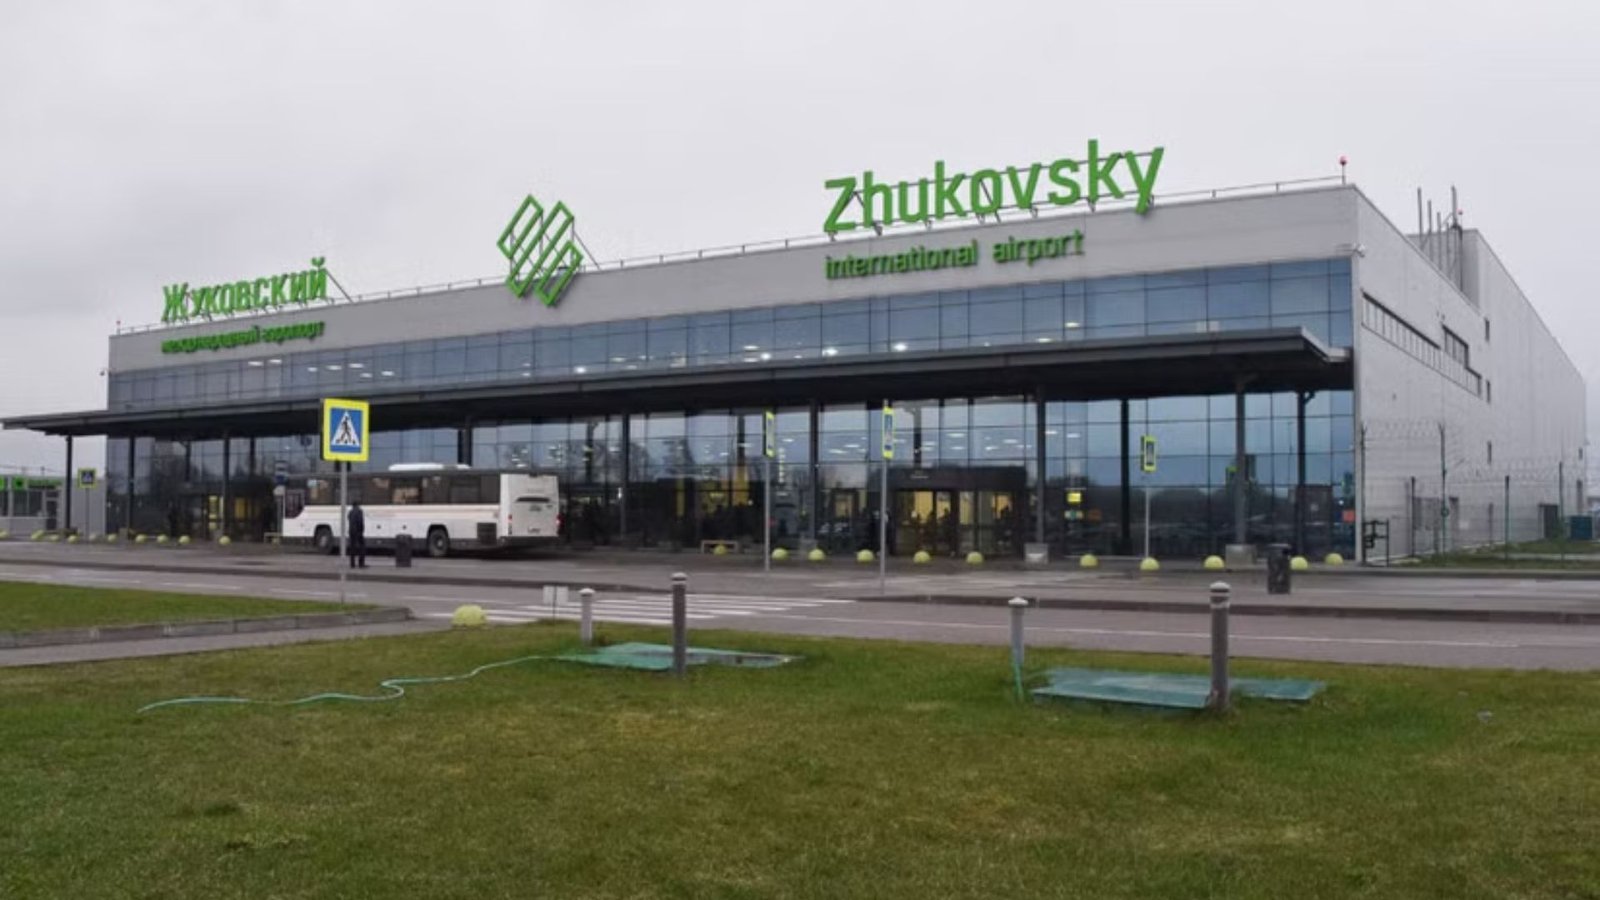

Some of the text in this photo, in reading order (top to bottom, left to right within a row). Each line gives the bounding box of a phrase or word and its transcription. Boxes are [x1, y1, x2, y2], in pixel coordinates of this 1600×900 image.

[823, 139, 1165, 233] Zhukovsky
[825, 228, 1084, 280] international airport
